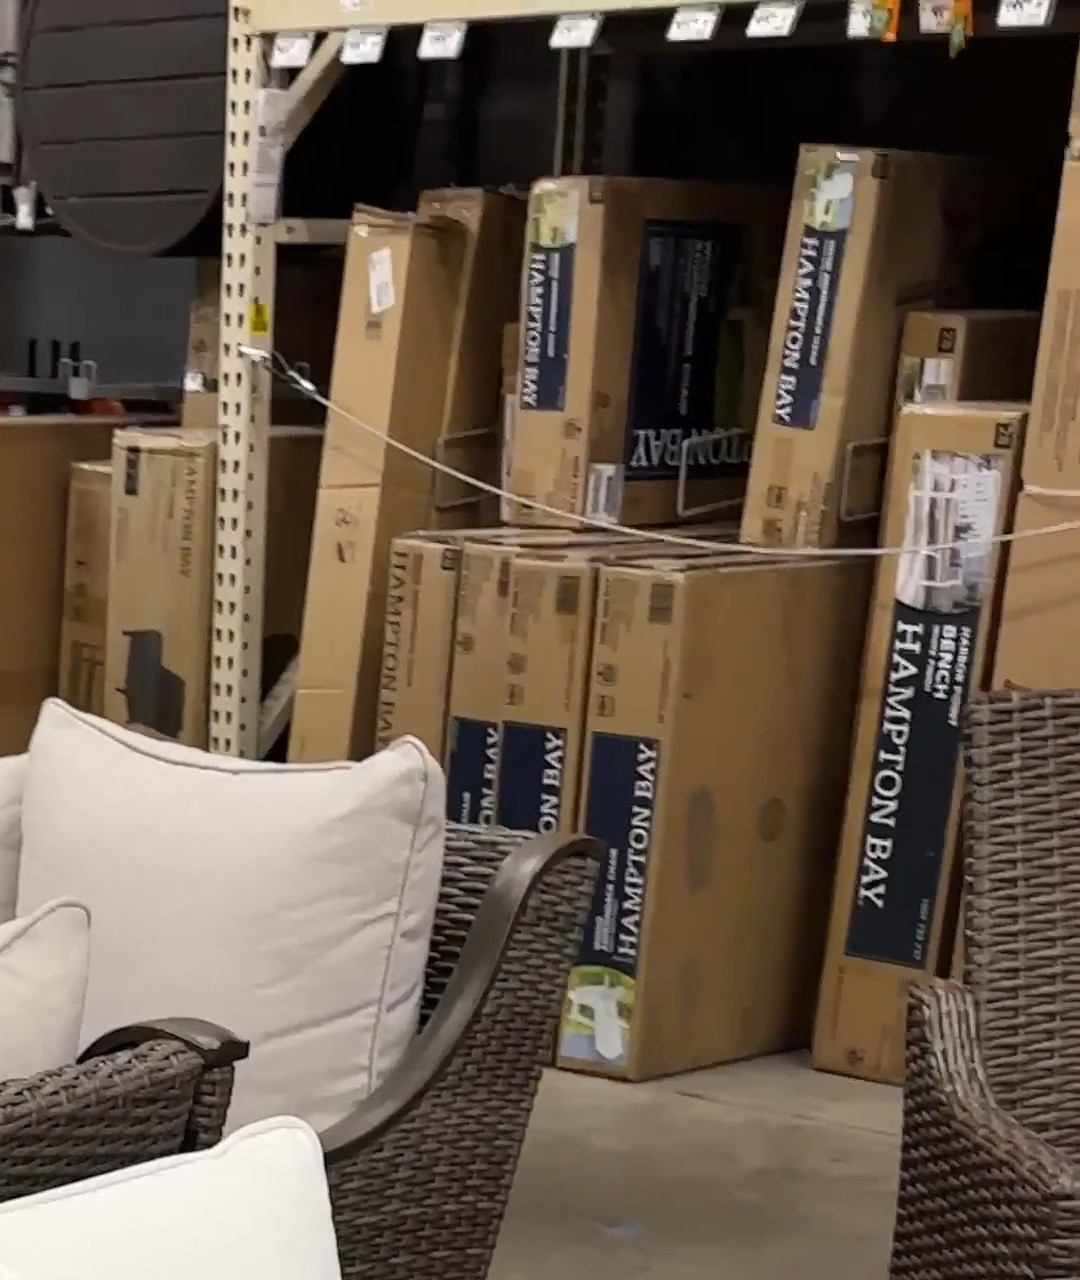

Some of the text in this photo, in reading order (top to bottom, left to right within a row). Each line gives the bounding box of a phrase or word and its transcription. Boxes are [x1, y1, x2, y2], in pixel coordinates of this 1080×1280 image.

[775, 236, 820, 423] HAMPTON BAY
[181, 467, 198, 541] AMPTON
[629, 429, 682, 467] BAY
[380, 550, 409, 699] HAMPTON
[932, 625, 957, 701] BENCH
[541, 731, 564, 787] BAY
[858, 619, 925, 909] HAMPTON BAY
[617, 742, 658, 957] HAMPTON BAY
